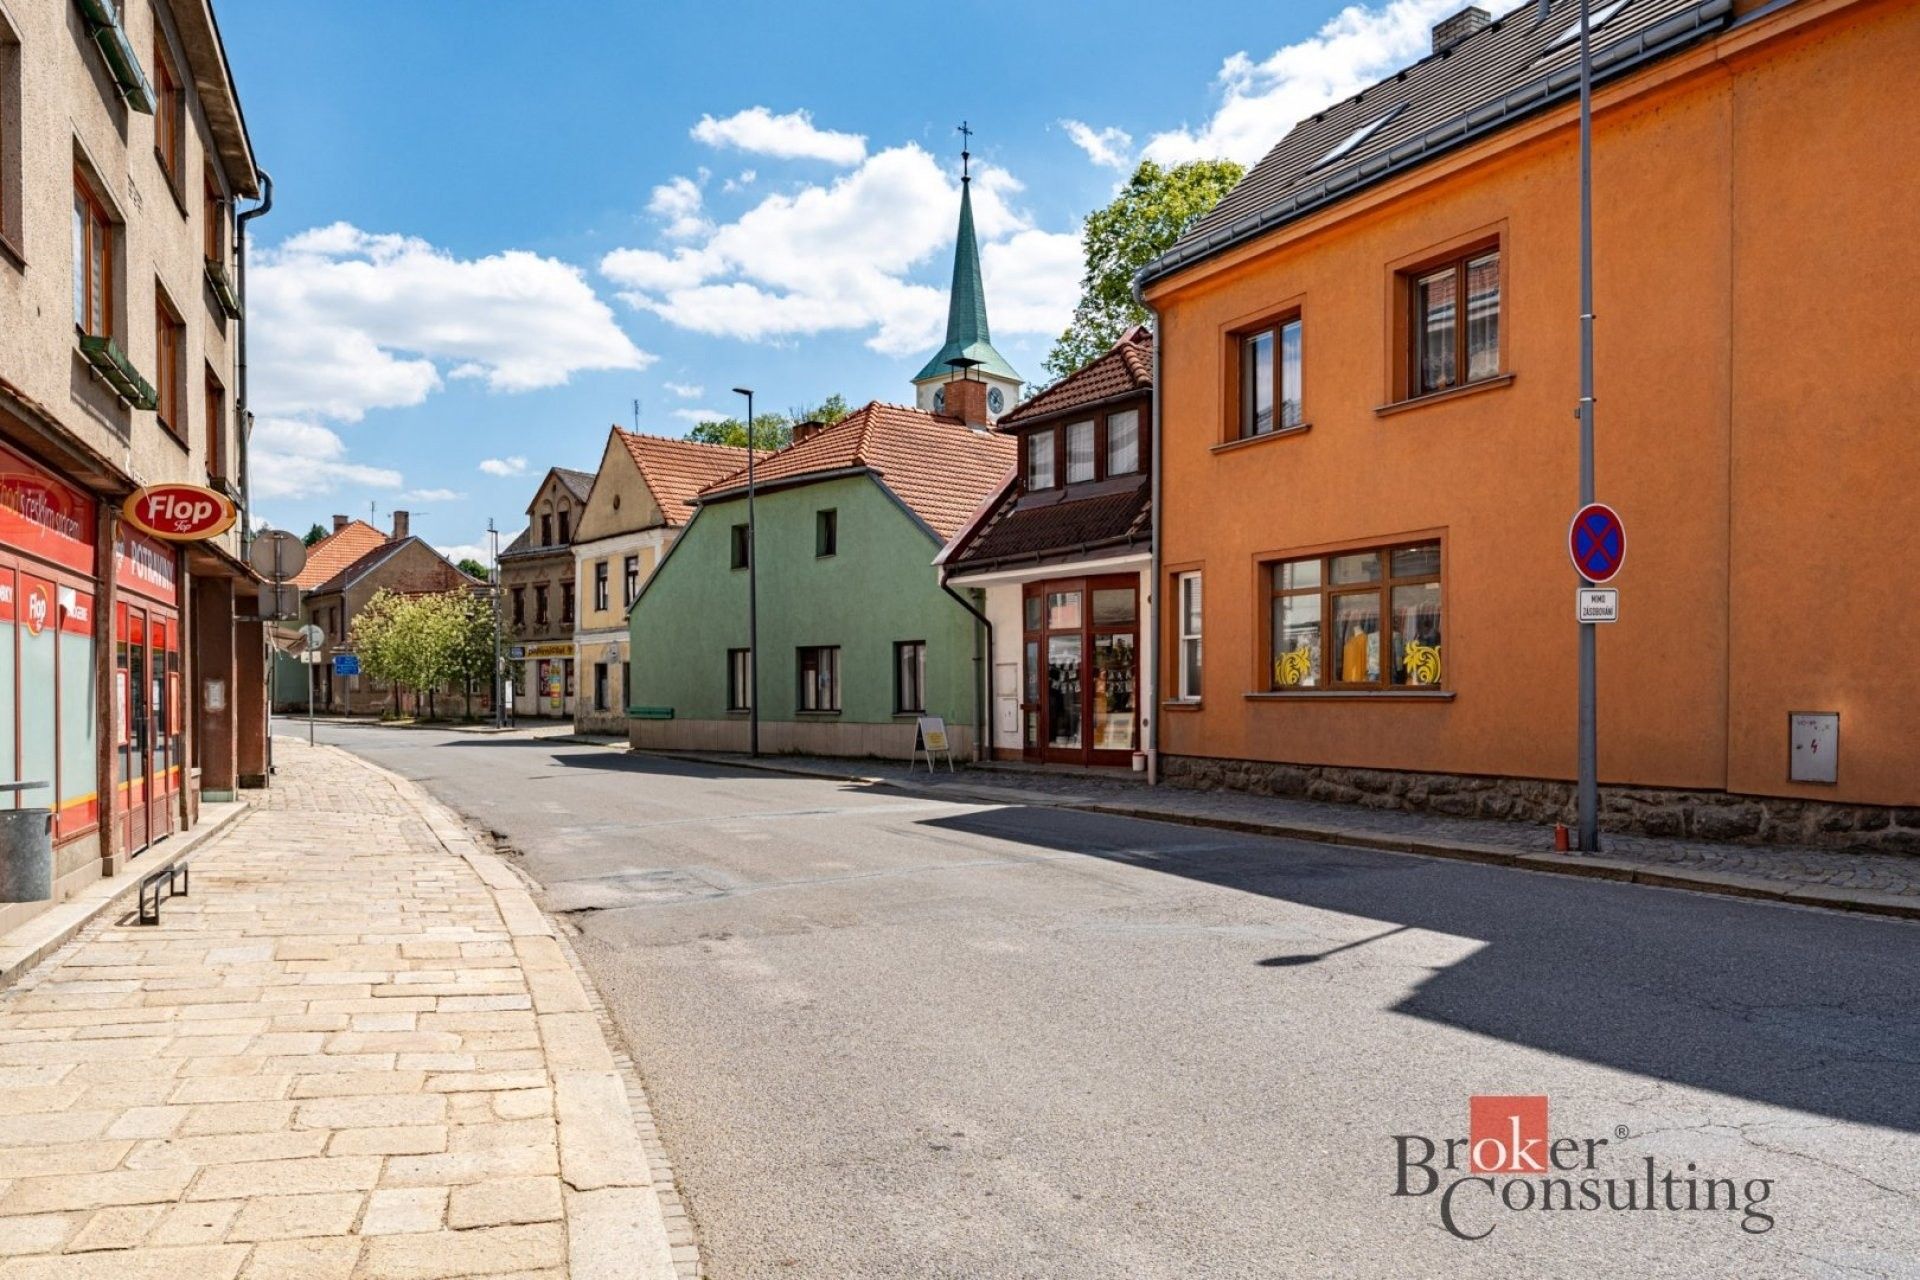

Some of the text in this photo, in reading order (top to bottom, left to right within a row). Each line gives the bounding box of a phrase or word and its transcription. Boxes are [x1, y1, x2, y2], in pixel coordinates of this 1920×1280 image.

[148, 495, 213, 525] Flop
[172, 520, 192, 534] Top
[1591, 595, 1606, 603] MIMO
